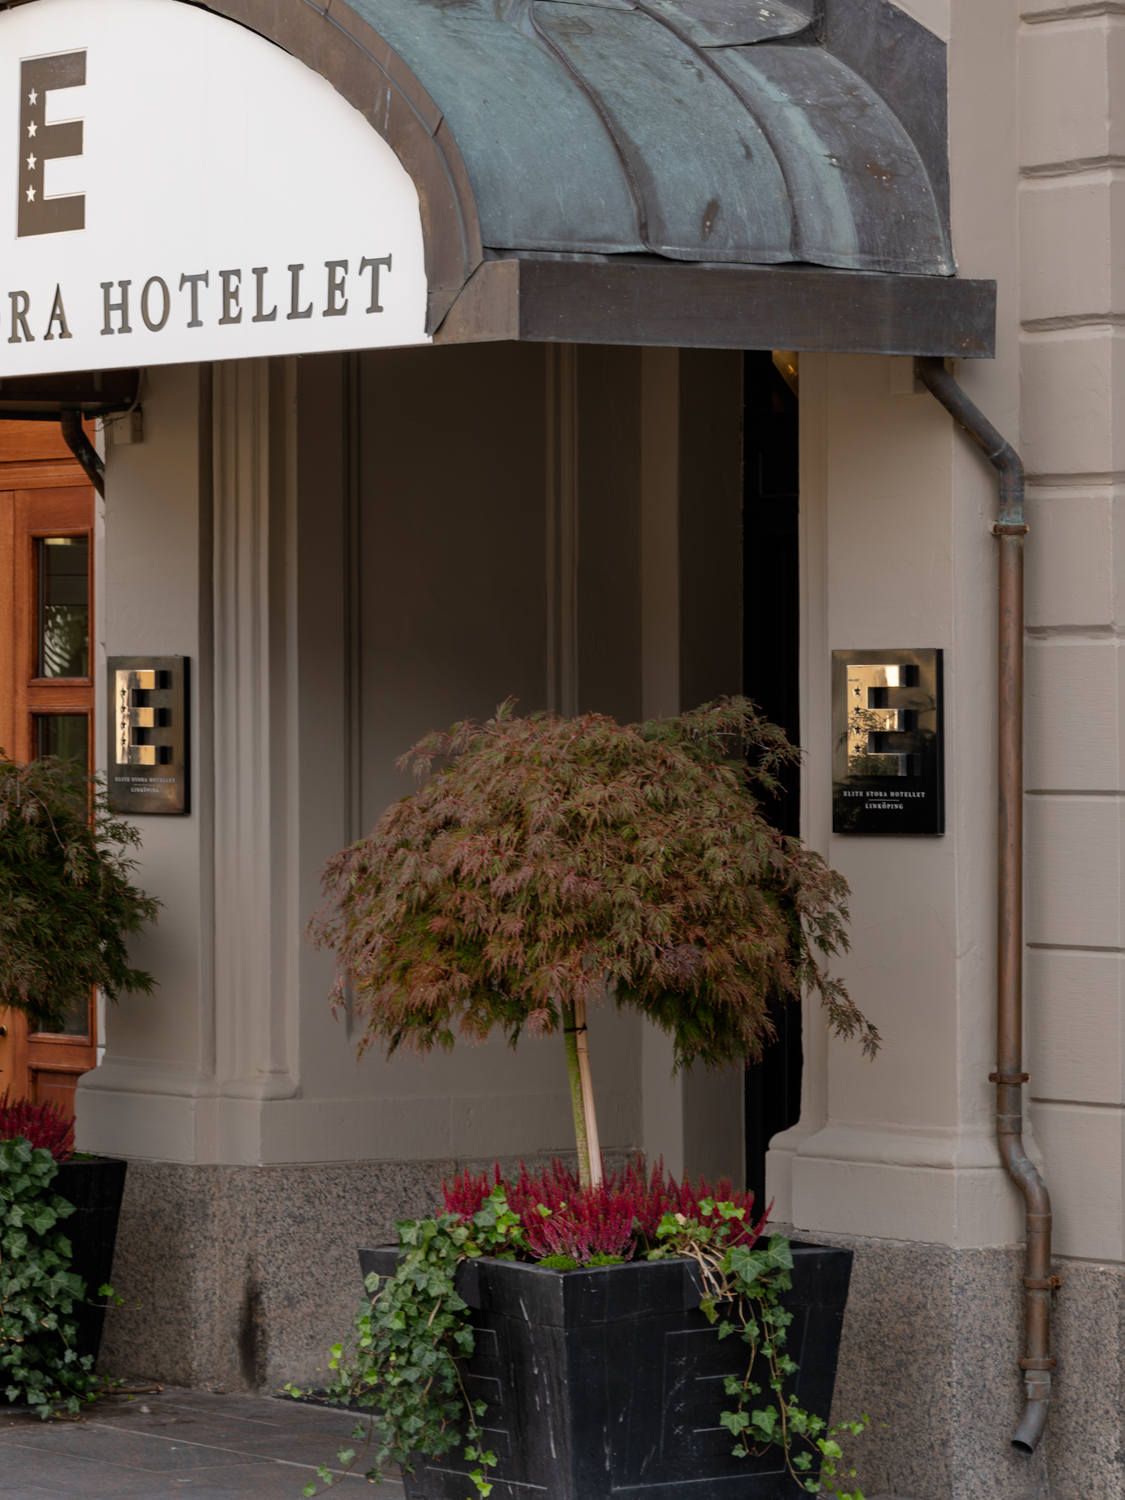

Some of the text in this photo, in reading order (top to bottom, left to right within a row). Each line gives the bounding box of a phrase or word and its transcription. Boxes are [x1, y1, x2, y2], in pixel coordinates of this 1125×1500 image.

[16, 47, 88, 240] E
[99, 253, 394, 336] HOTELLET
[865, 801, 904, 810] LINKÖPING
